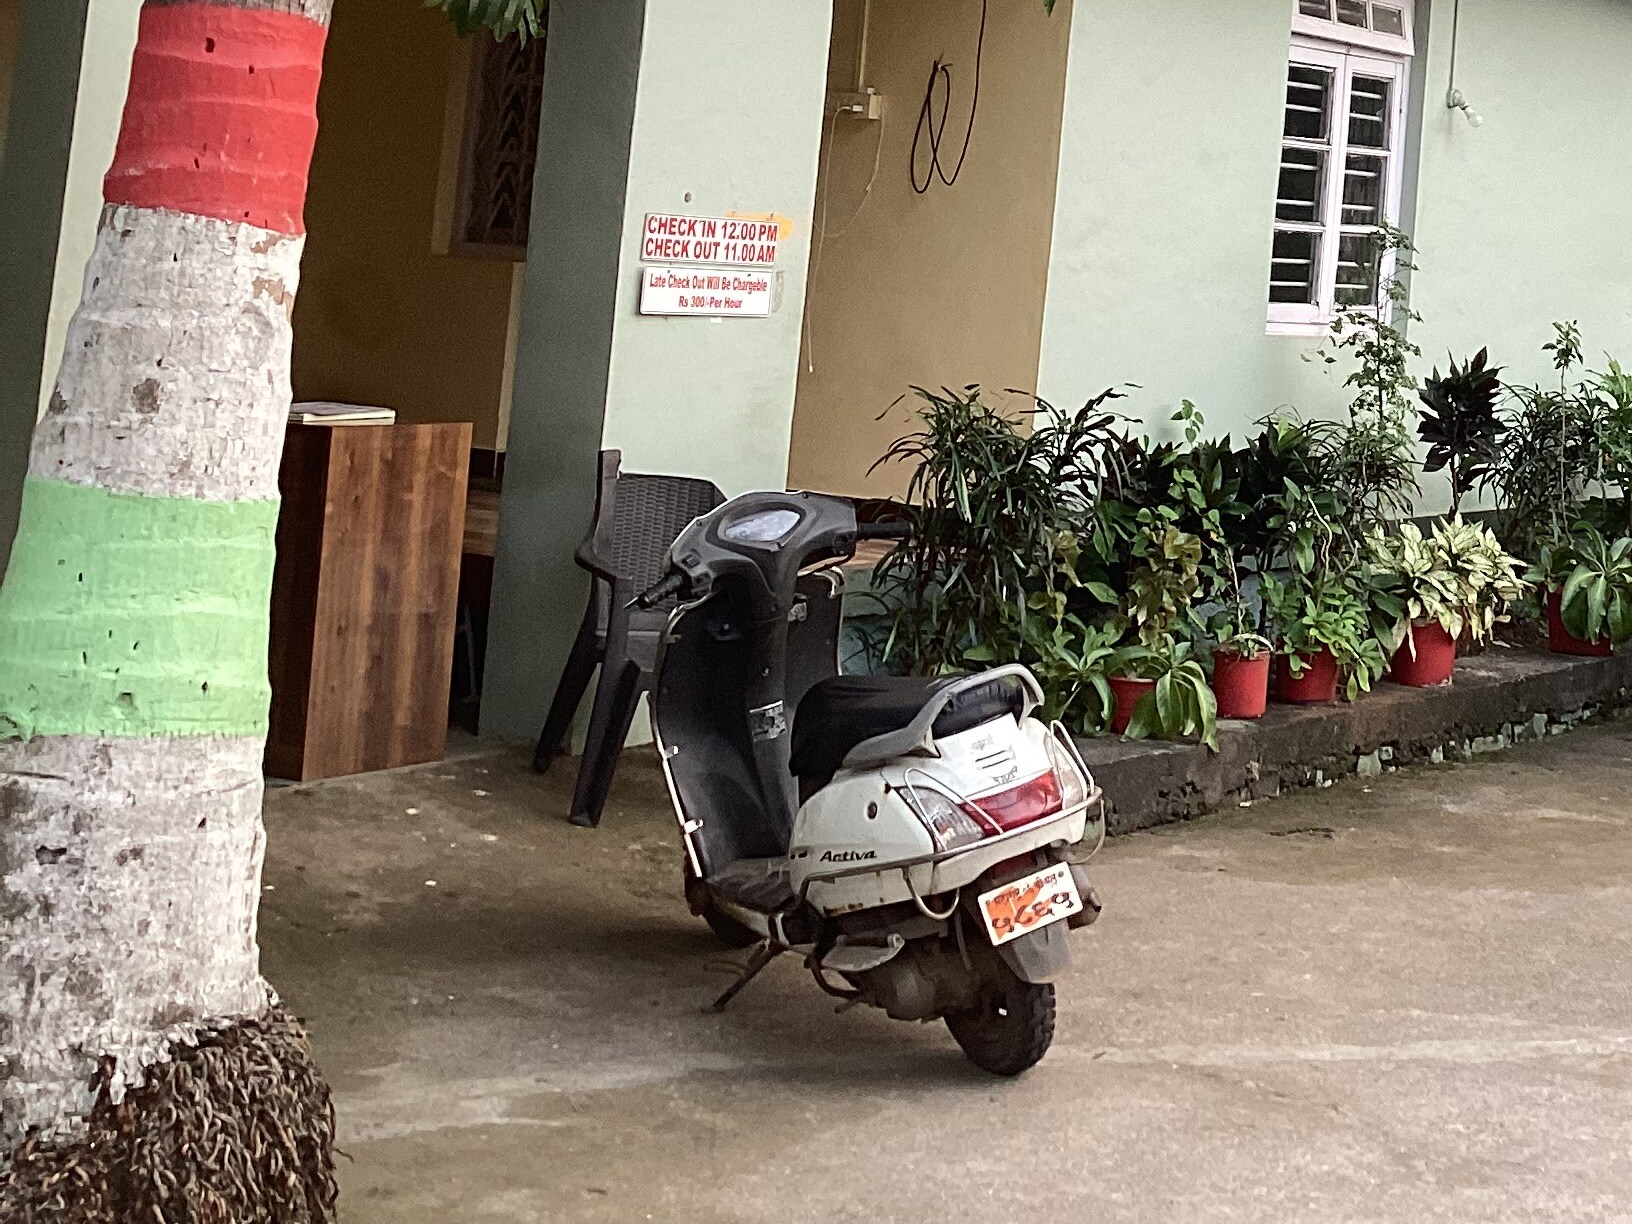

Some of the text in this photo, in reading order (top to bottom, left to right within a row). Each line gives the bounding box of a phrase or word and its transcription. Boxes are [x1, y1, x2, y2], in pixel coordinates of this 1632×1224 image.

[648, 216, 697, 237] CHECK
[702, 220, 716, 238] IN
[645, 238, 690, 258] CHECK
[694, 241, 720, 259] OUT
[650, 273, 666, 287] Late
[668, 274, 690, 288] Check
[692, 275, 705, 289] Out
[706, 276, 720, 289] Will
[722, 277, 731, 290] Be
[679, 296, 688, 307] Rs
[724, 296, 742, 308] Hour
[819, 850, 877, 862] Activa
